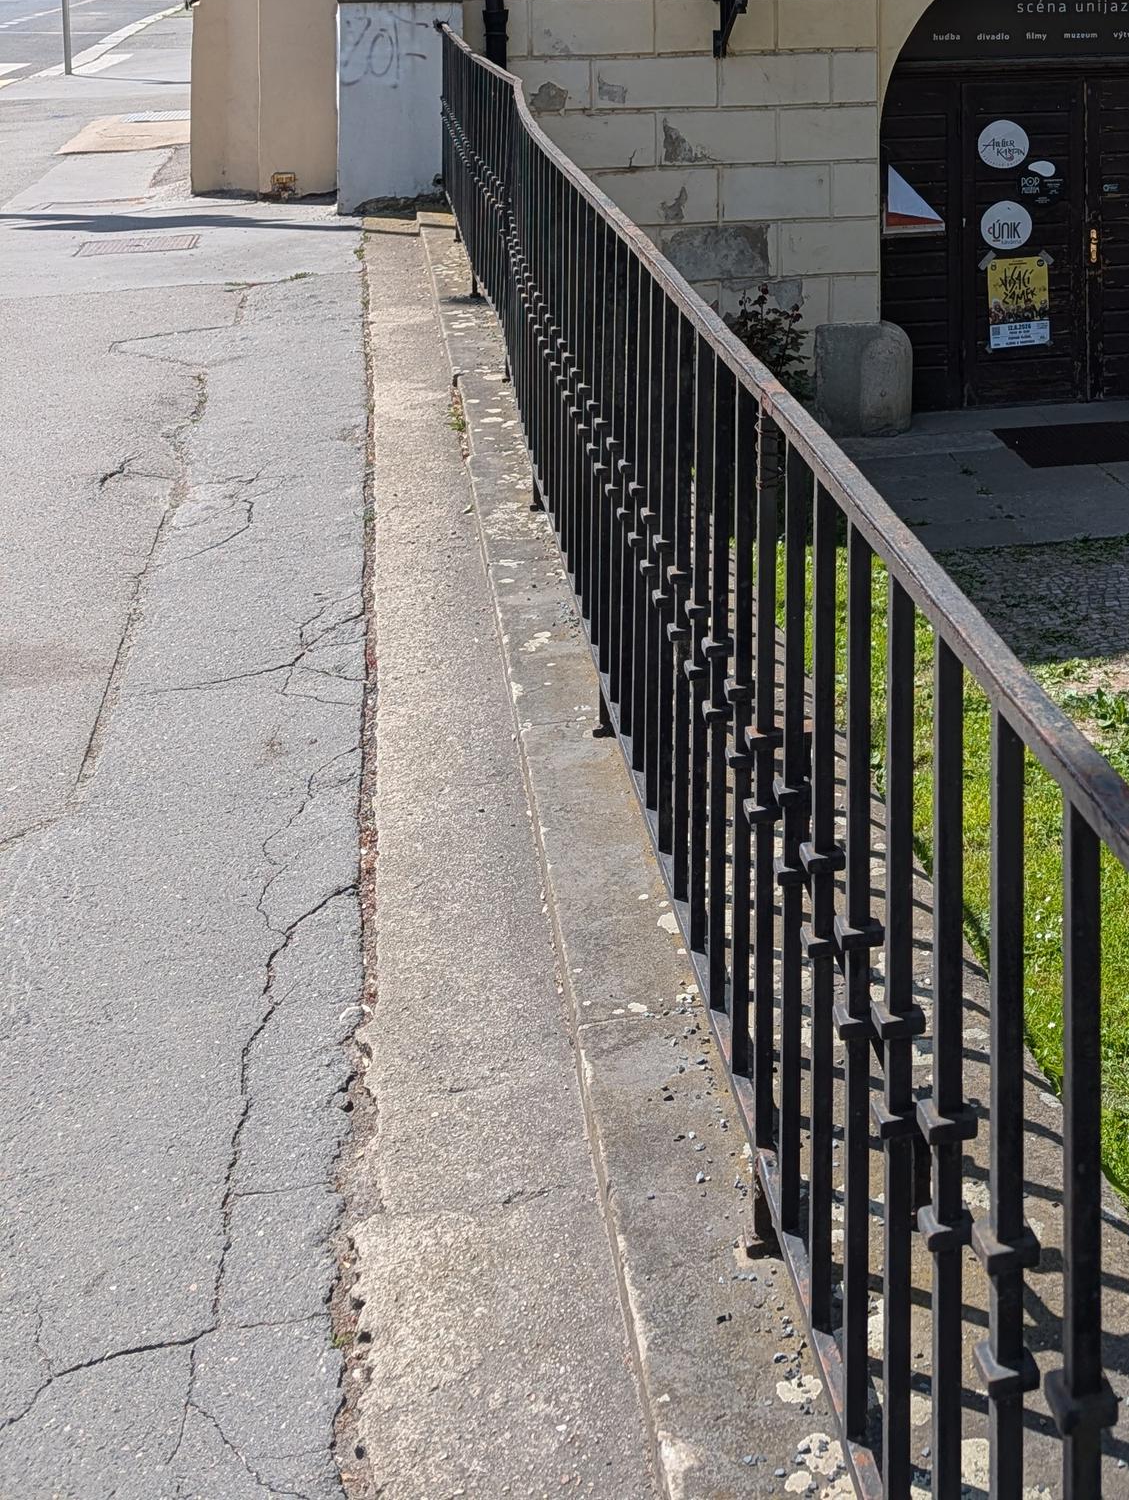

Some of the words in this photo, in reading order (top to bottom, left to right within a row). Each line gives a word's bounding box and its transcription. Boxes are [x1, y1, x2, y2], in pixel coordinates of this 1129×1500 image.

[1016, 0, 1067, 13] scéna
[932, 32, 961, 41] hudba
[976, 32, 1010, 41] divadlo
[1025, 31, 1048, 41] filmy
[1063, 31, 1098, 39] muzeum
